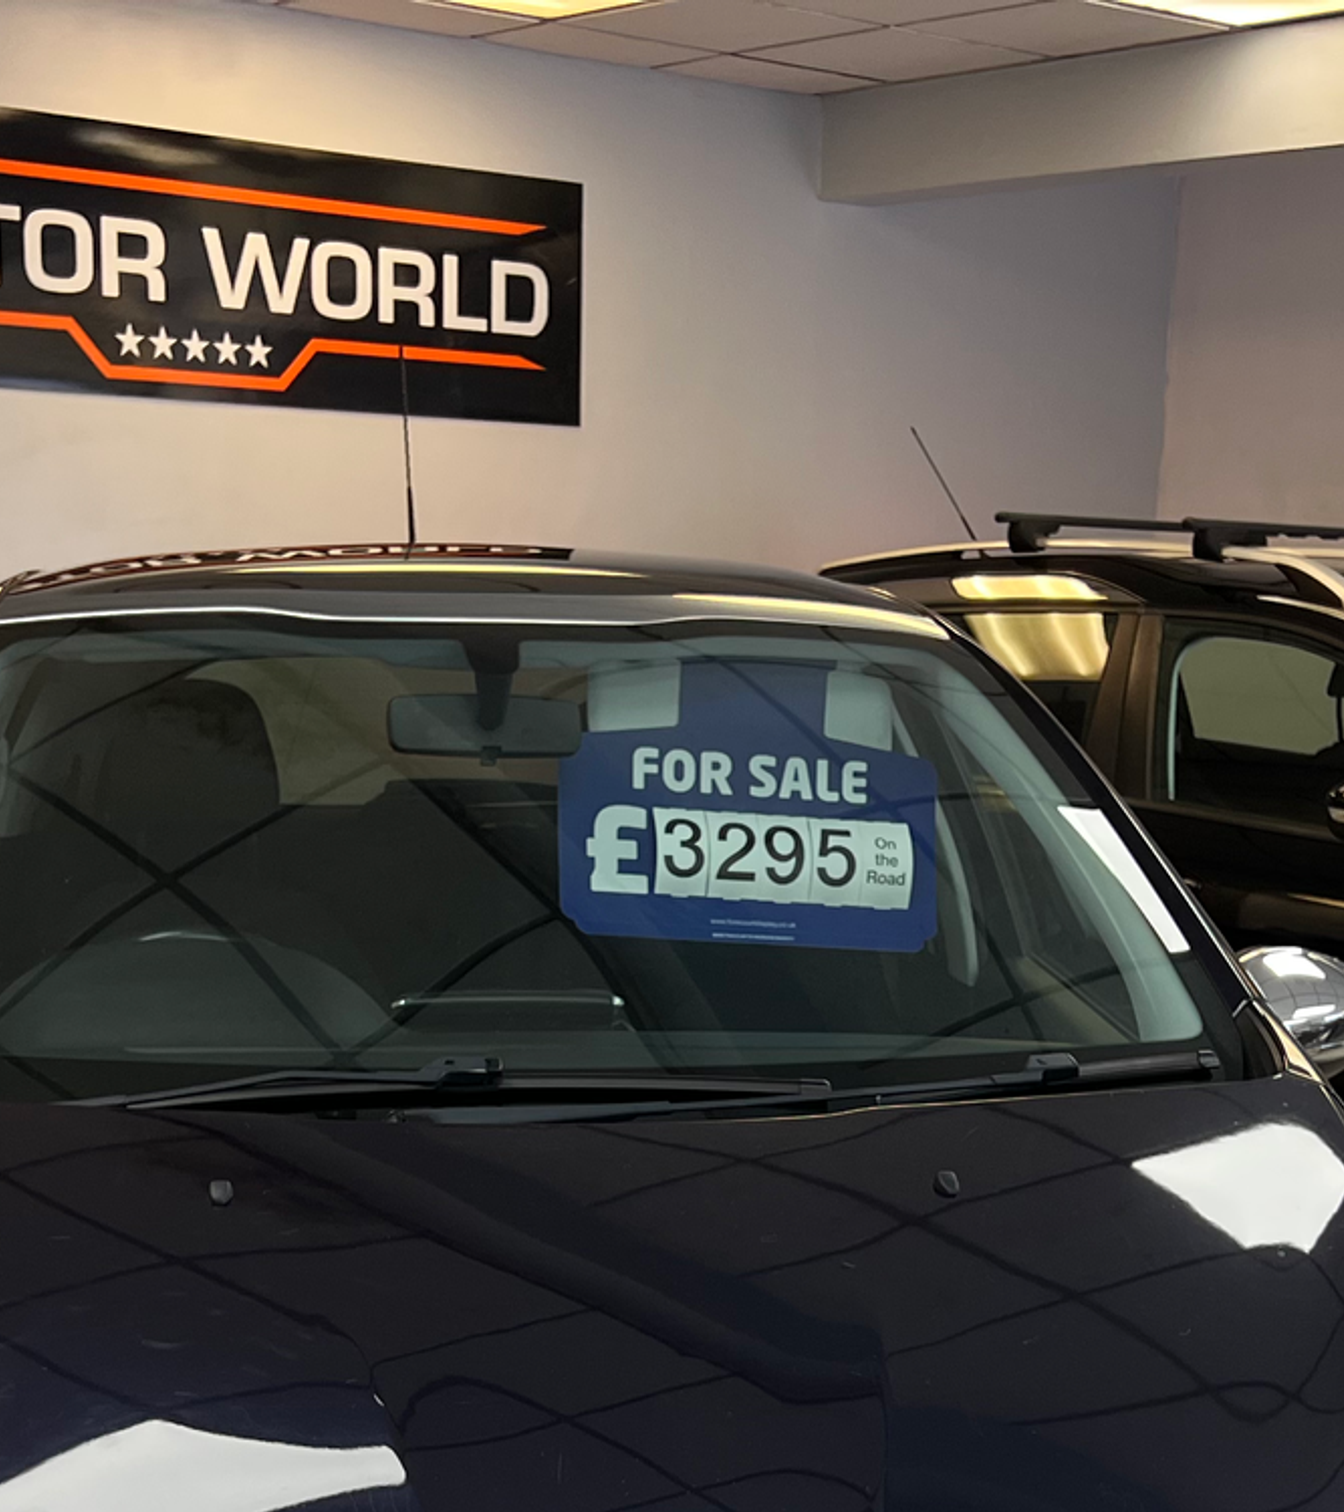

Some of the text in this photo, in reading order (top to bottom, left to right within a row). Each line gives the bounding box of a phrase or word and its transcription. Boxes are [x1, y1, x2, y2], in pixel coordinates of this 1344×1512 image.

[201, 225, 550, 338] WORLD
[632, 746, 868, 804] FOR SALE
[874, 836, 898, 850] On
[875, 853, 899, 868] the
[866, 869, 906, 886] Road
